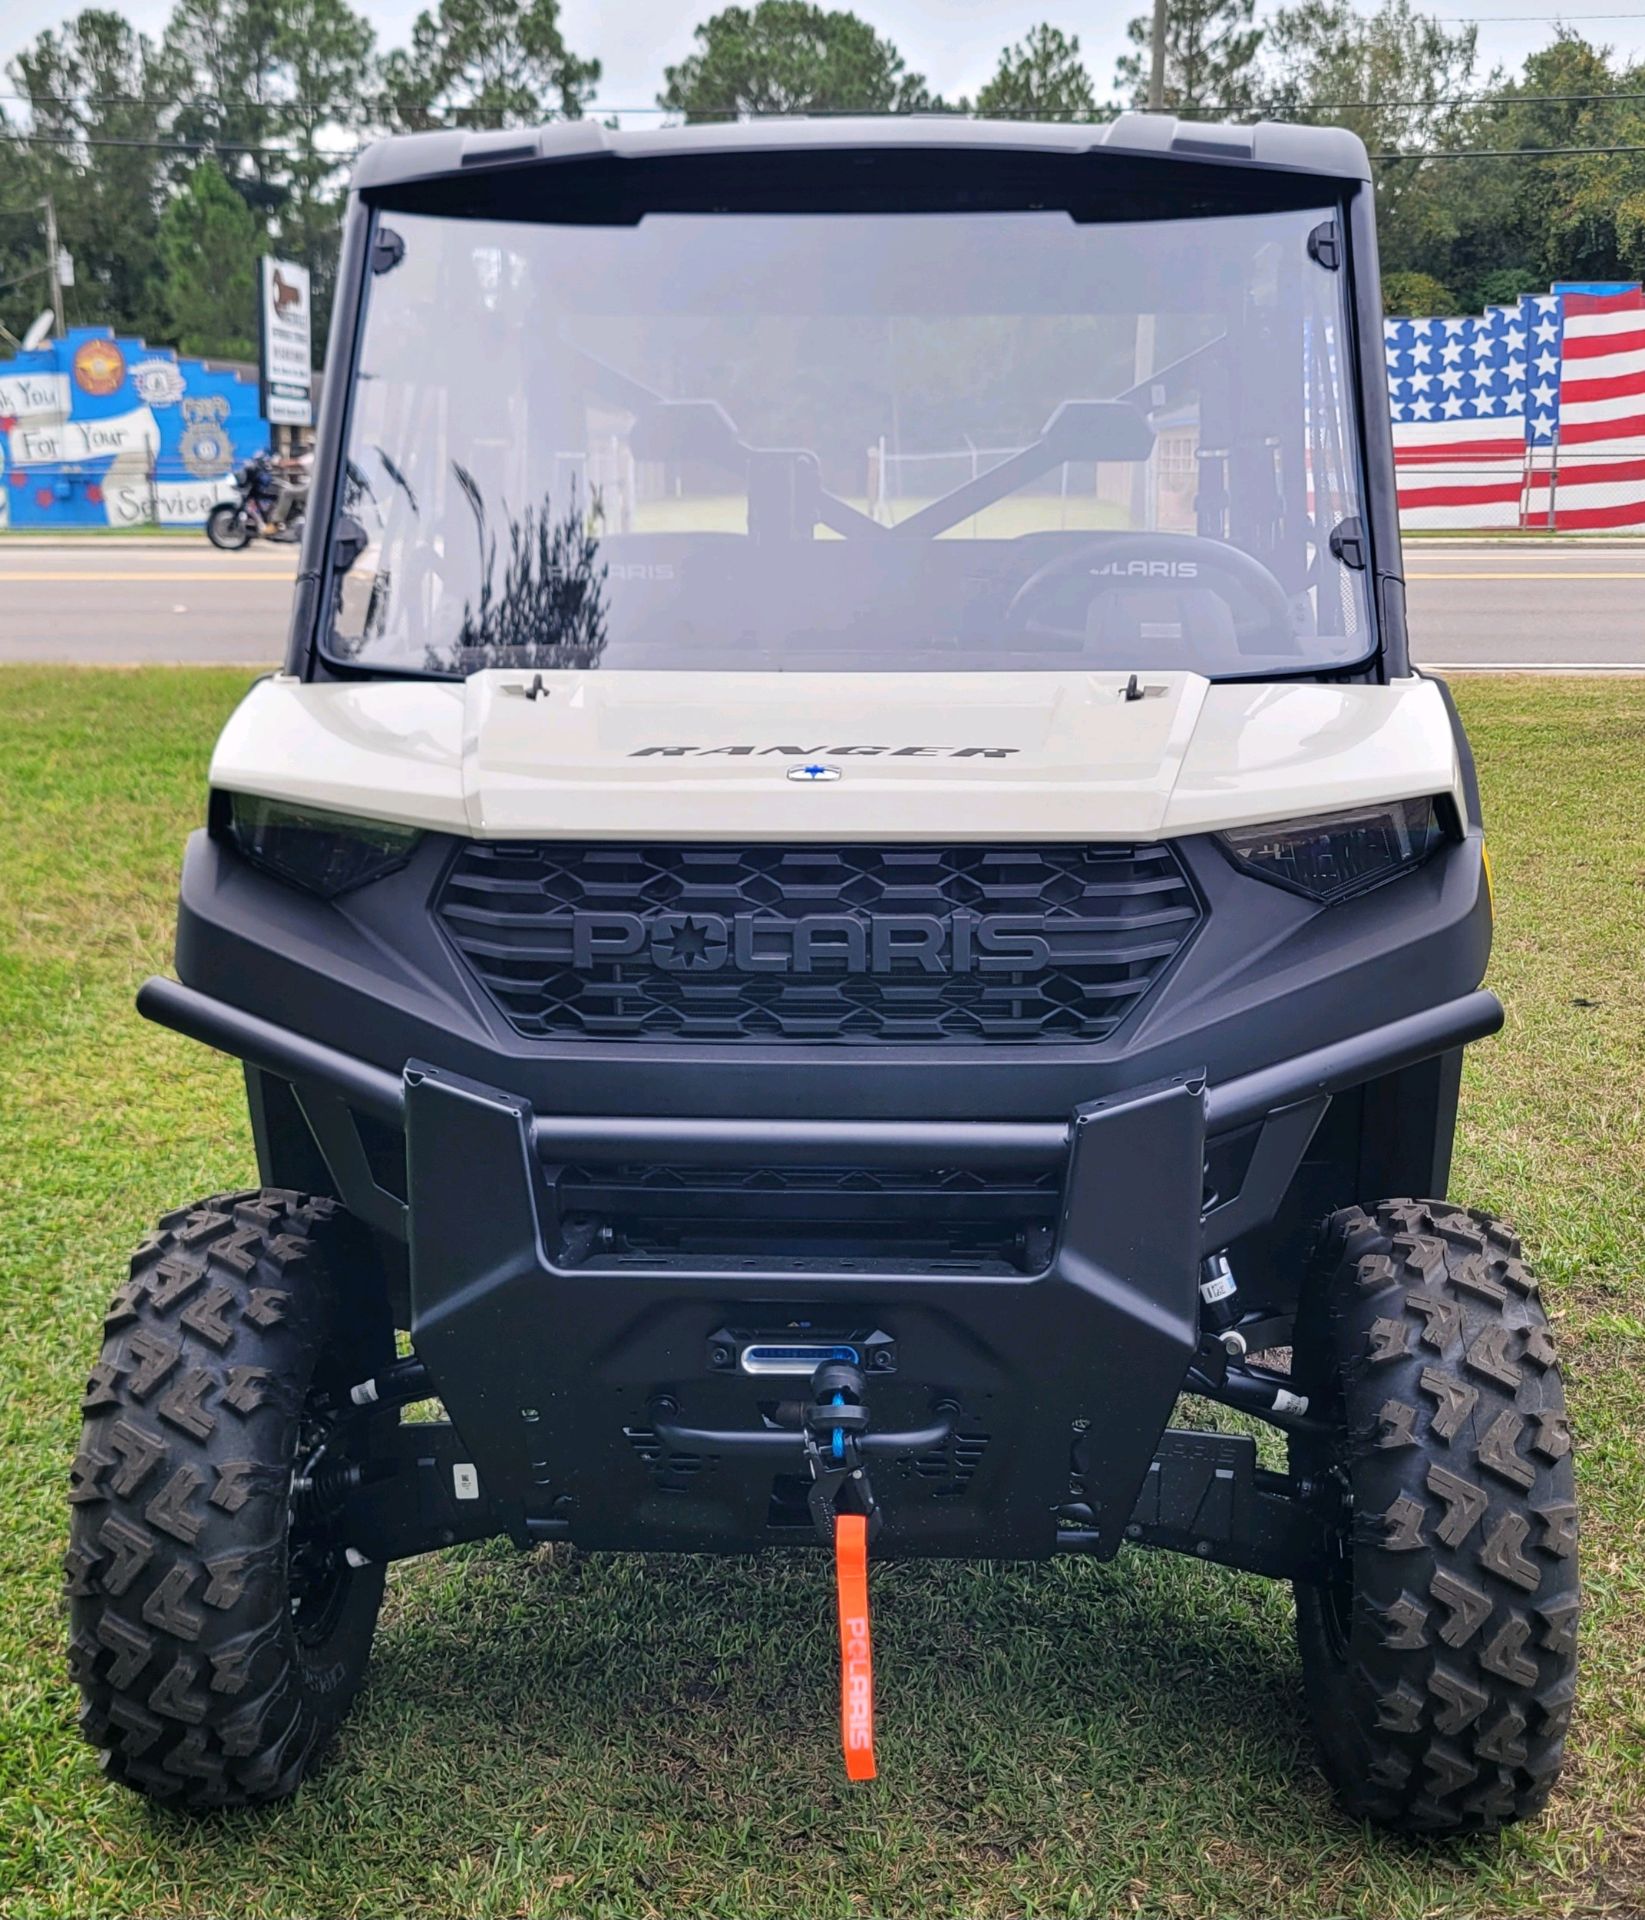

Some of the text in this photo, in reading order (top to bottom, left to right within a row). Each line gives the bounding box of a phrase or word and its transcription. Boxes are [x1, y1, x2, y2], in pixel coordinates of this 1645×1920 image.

[17, 380, 57, 407] You
[23, 422, 127, 459] For Your
[628, 745, 1020, 758] RANGER
[573, 911, 1050, 973] POLARIS
[845, 1616, 870, 1750] POLARIS
